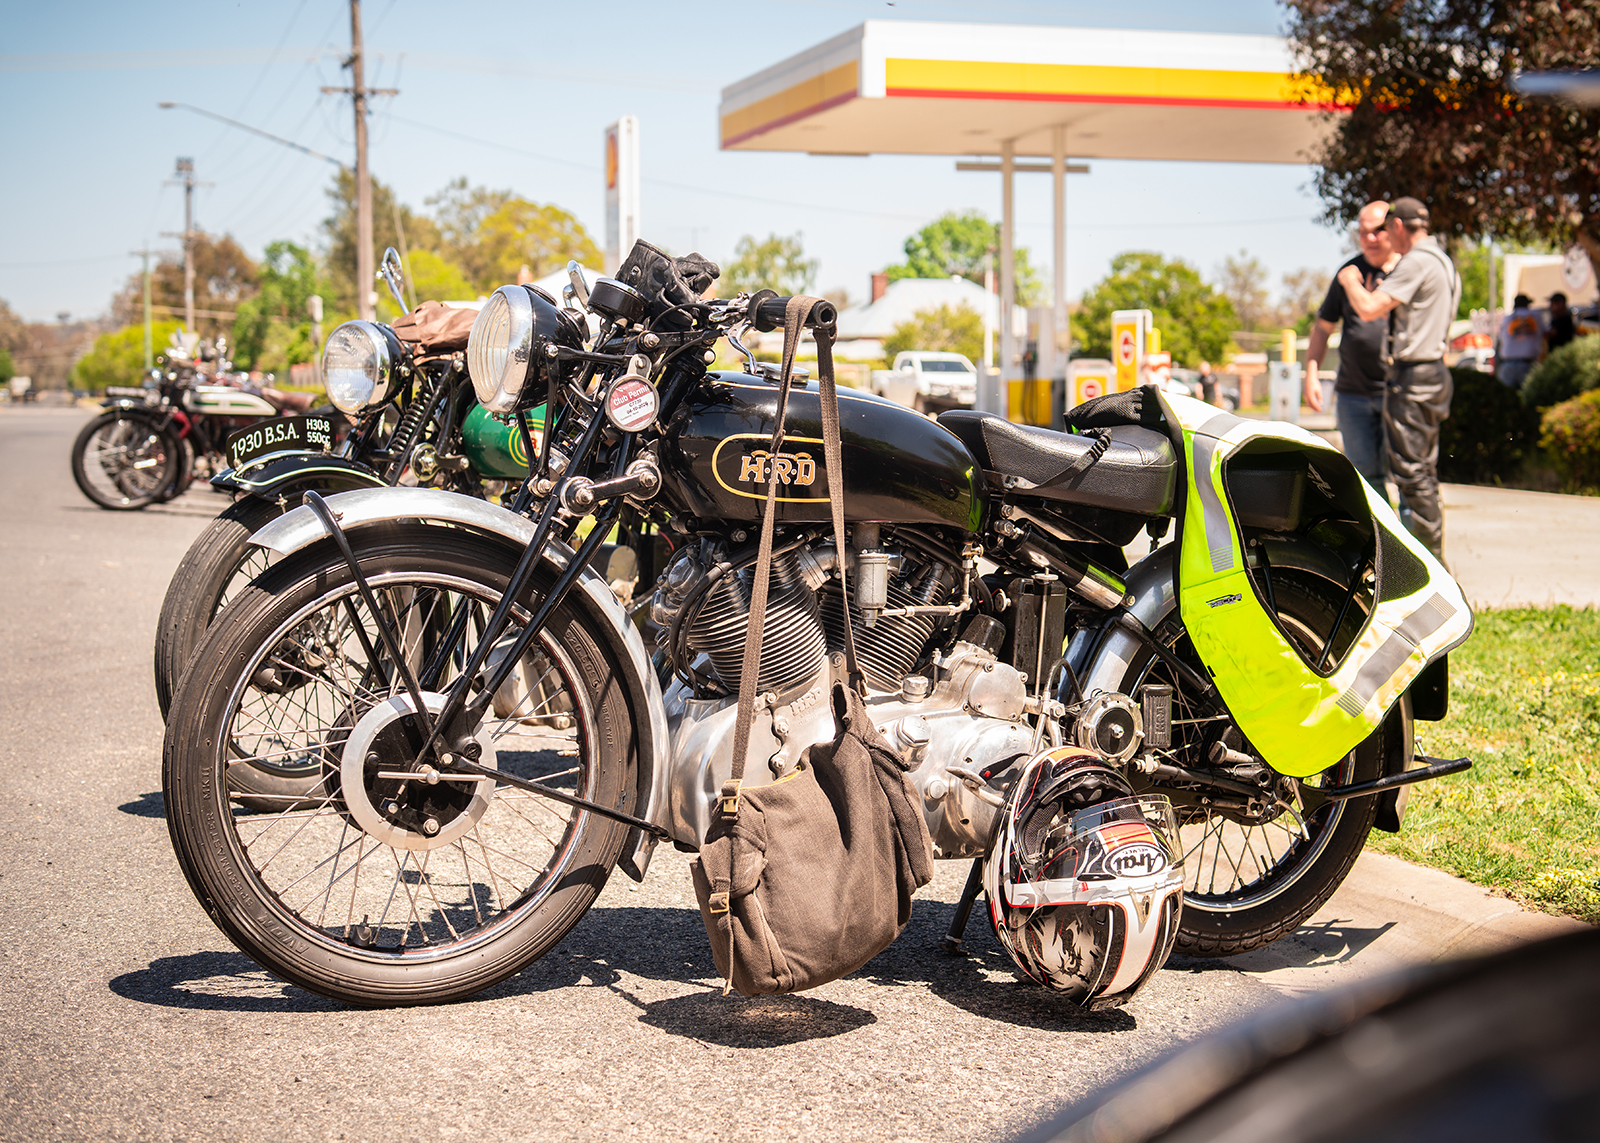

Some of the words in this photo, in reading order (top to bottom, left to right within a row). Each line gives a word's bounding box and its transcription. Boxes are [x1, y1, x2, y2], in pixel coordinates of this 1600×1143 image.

[613, 395, 629, 406] Club
[629, 384, 650, 399] Permit
[306, 418, 330, 433] H30-8
[231, 430, 263, 458] 1930
[264, 422, 300, 445] B.S.A.
[307, 431, 331, 444] 550cc
[1113, 852, 1163, 875] Arai
[257, 912, 310, 954] AVON
